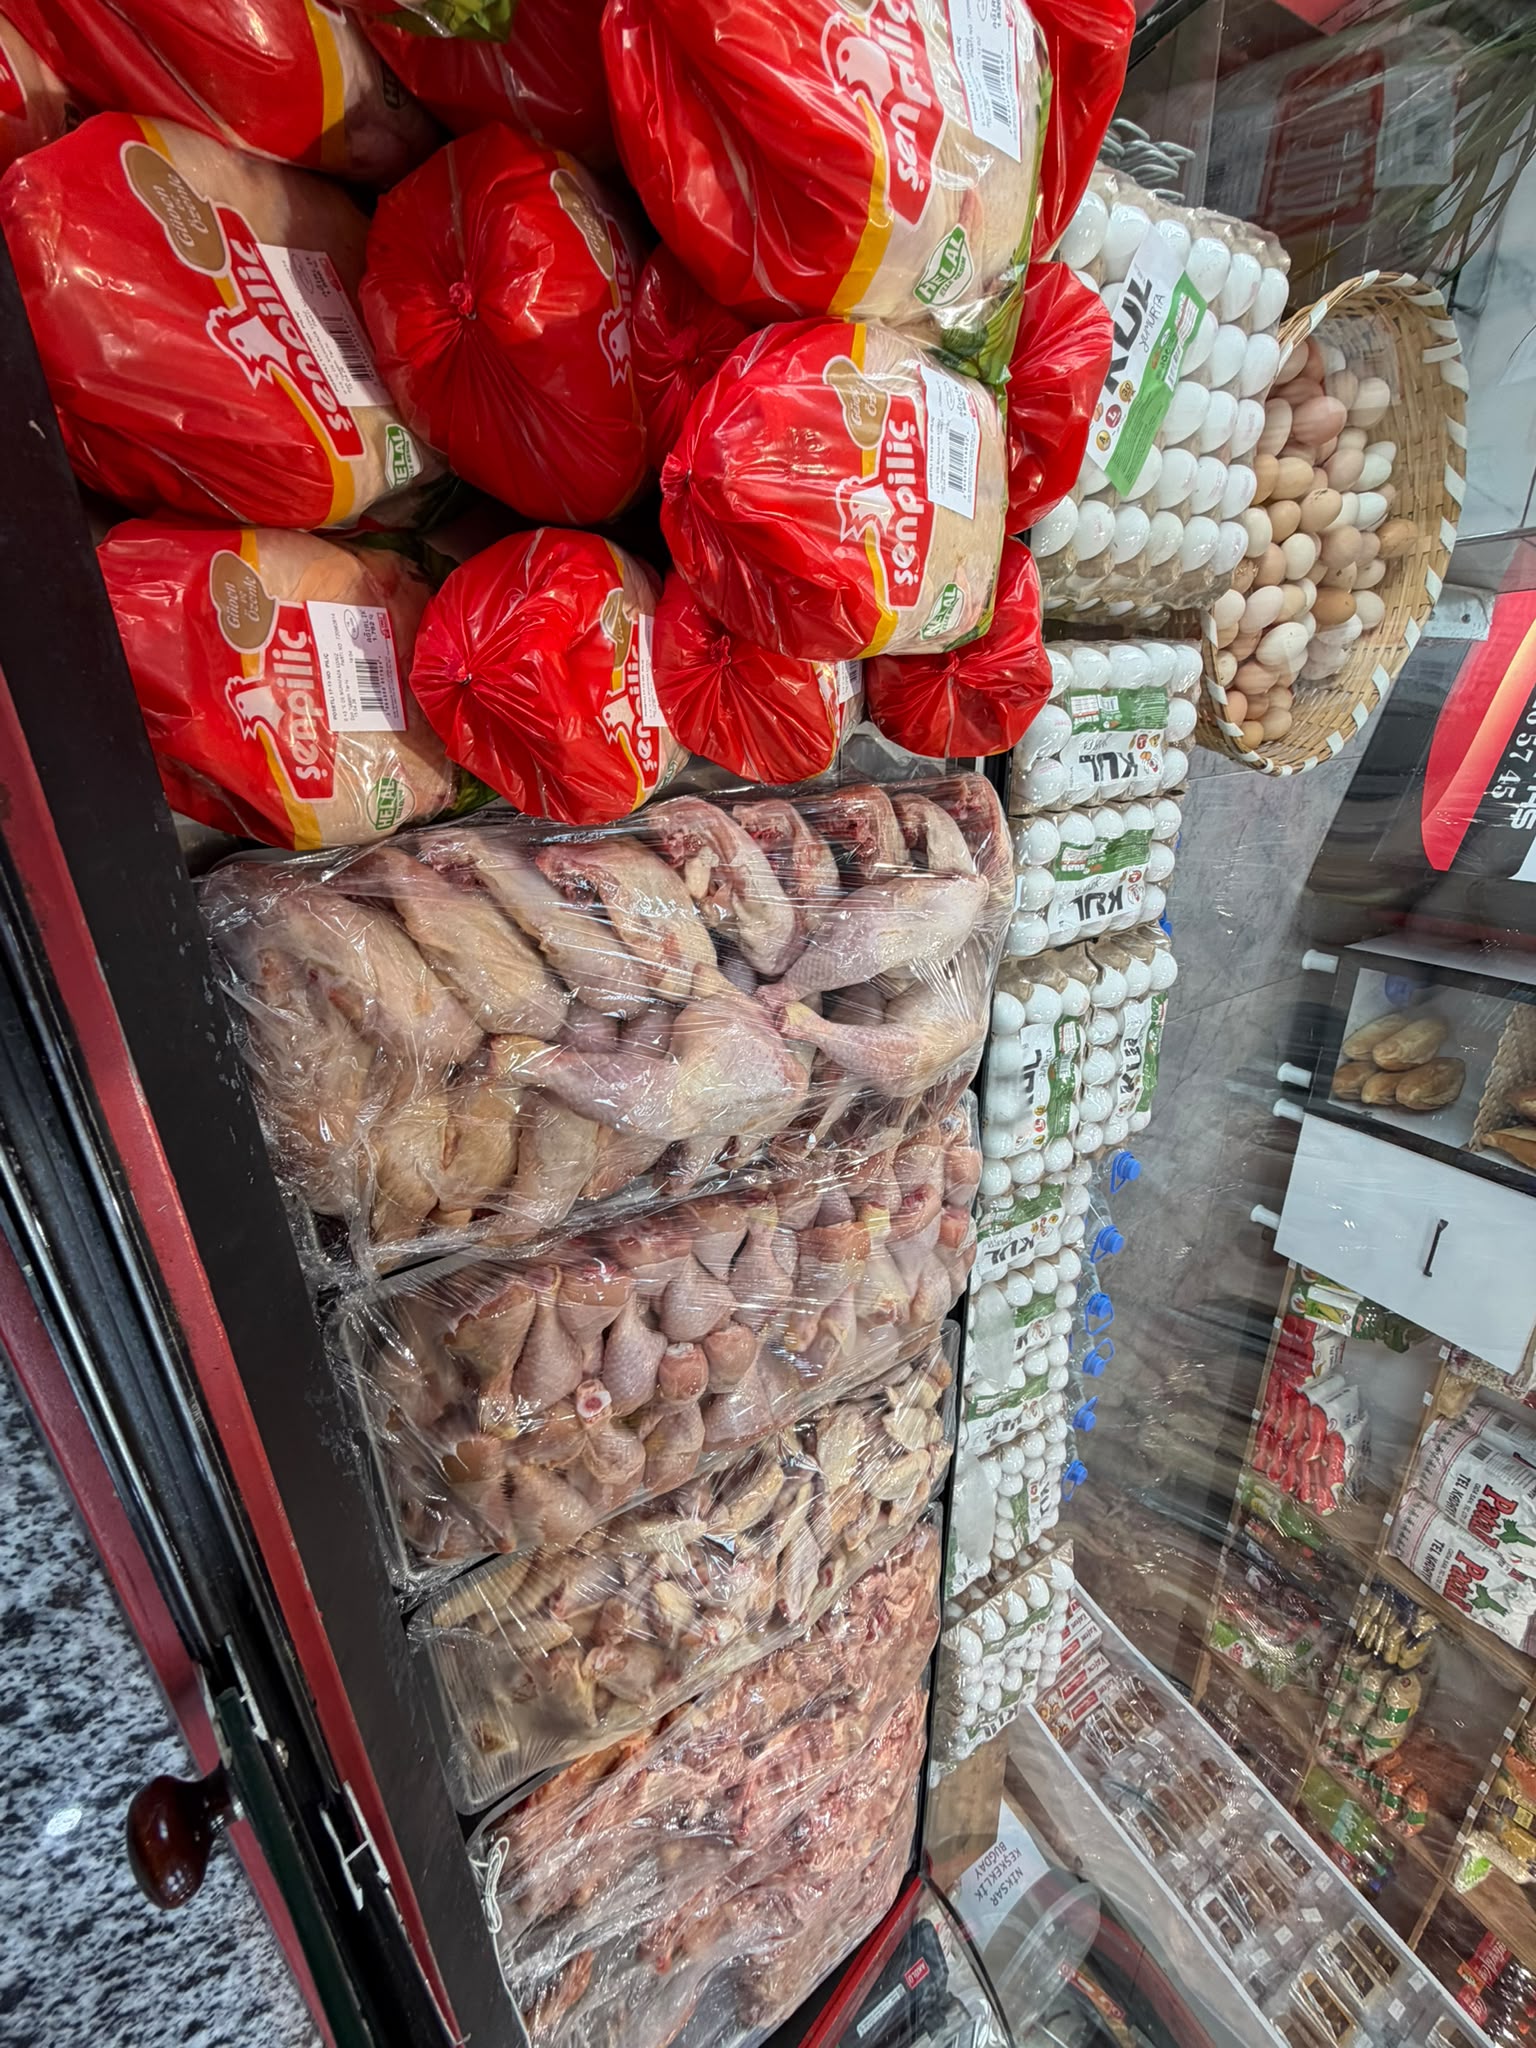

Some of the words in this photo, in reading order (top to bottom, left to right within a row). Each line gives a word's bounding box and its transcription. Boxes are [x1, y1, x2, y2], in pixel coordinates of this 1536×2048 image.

[917, 230, 962, 300] HELAL
[886, 418, 924, 586] şenpiliç
[223, 582, 241, 629] Güven
[241, 574, 261, 623] Özenle
[271, 628, 329, 781] şenpiliç
[1079, 752, 1138, 783] KUL
[1491, 769, 1522, 800] 45
[376, 780, 397, 829] HELAL
[1068, 885, 1124, 922] KUL
[984, 1234, 1035, 1266] KUL
[1454, 1473, 1472, 1490] TEL
[1429, 1539, 1446, 1556] TEL
[973, 1840, 1007, 1880] BUĞDAY
[973, 1847, 1022, 1902] KEŞKEKLİK
[989, 1865, 1024, 1908] NİKSAR
